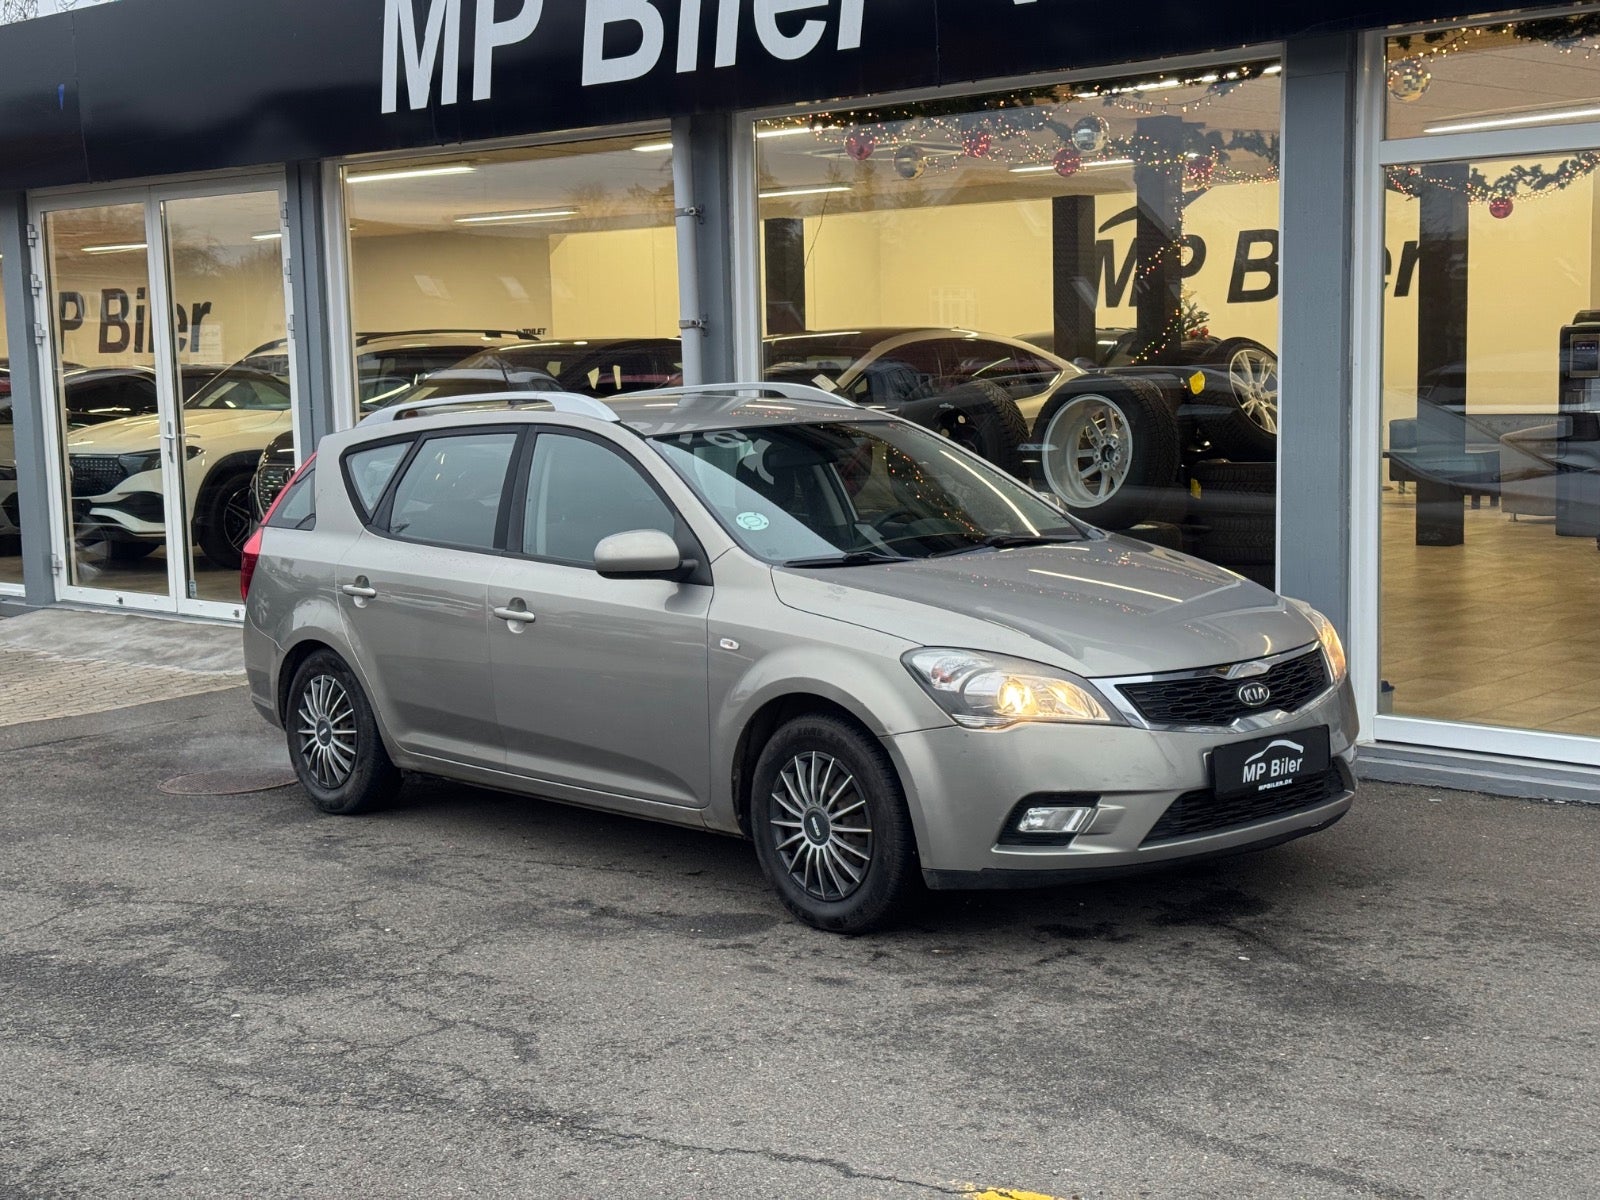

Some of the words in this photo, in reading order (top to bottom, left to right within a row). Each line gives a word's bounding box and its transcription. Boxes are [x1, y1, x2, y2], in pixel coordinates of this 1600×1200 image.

[381, 0, 544, 114] MP
[98, 287, 212, 354] Bier
[522, 327, 547, 336] TOILET
[1243, 687, 1267, 702] KIA
[1242, 762, 1267, 783] MP
[1270, 756, 1303, 778] Biler
